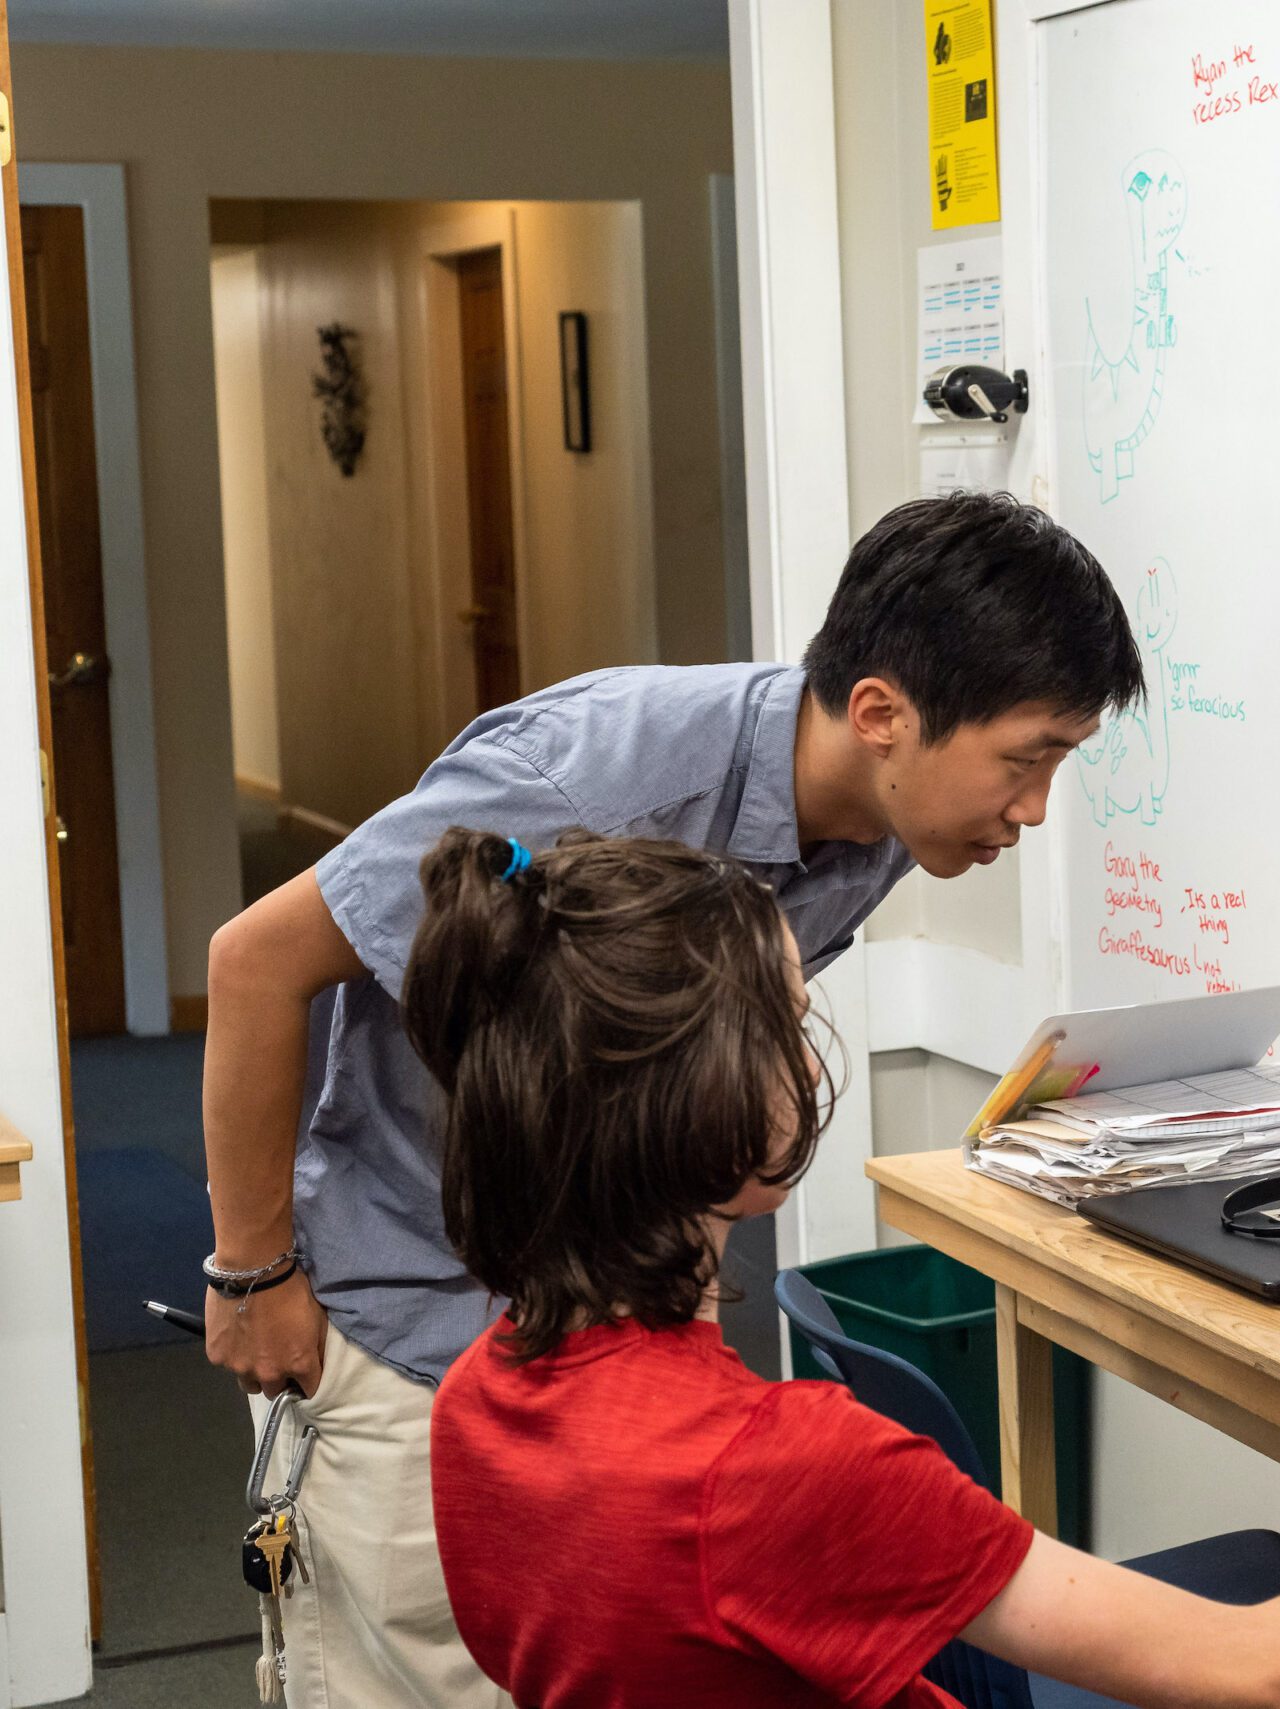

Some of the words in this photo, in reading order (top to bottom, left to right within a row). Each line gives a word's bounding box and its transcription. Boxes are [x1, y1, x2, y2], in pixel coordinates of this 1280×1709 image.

[1191, 53, 1227, 96] Ryan
[1232, 44, 1256, 68] the
[1192, 91, 1242, 125] recess
[1247, 75, 1279, 105] Rex
[1170, 694, 1185, 711] so
[1187, 683, 1247, 722] ferocious
[1103, 840, 1139, 892] Gary
[1139, 850, 1163, 882] the
[1104, 887, 1163, 928] geometry
[1210, 893, 1221, 910] a
[1198, 914, 1230, 945] thing
[1097, 925, 1191, 976] Giraffesaurus
[1203, 958, 1222, 978] not
